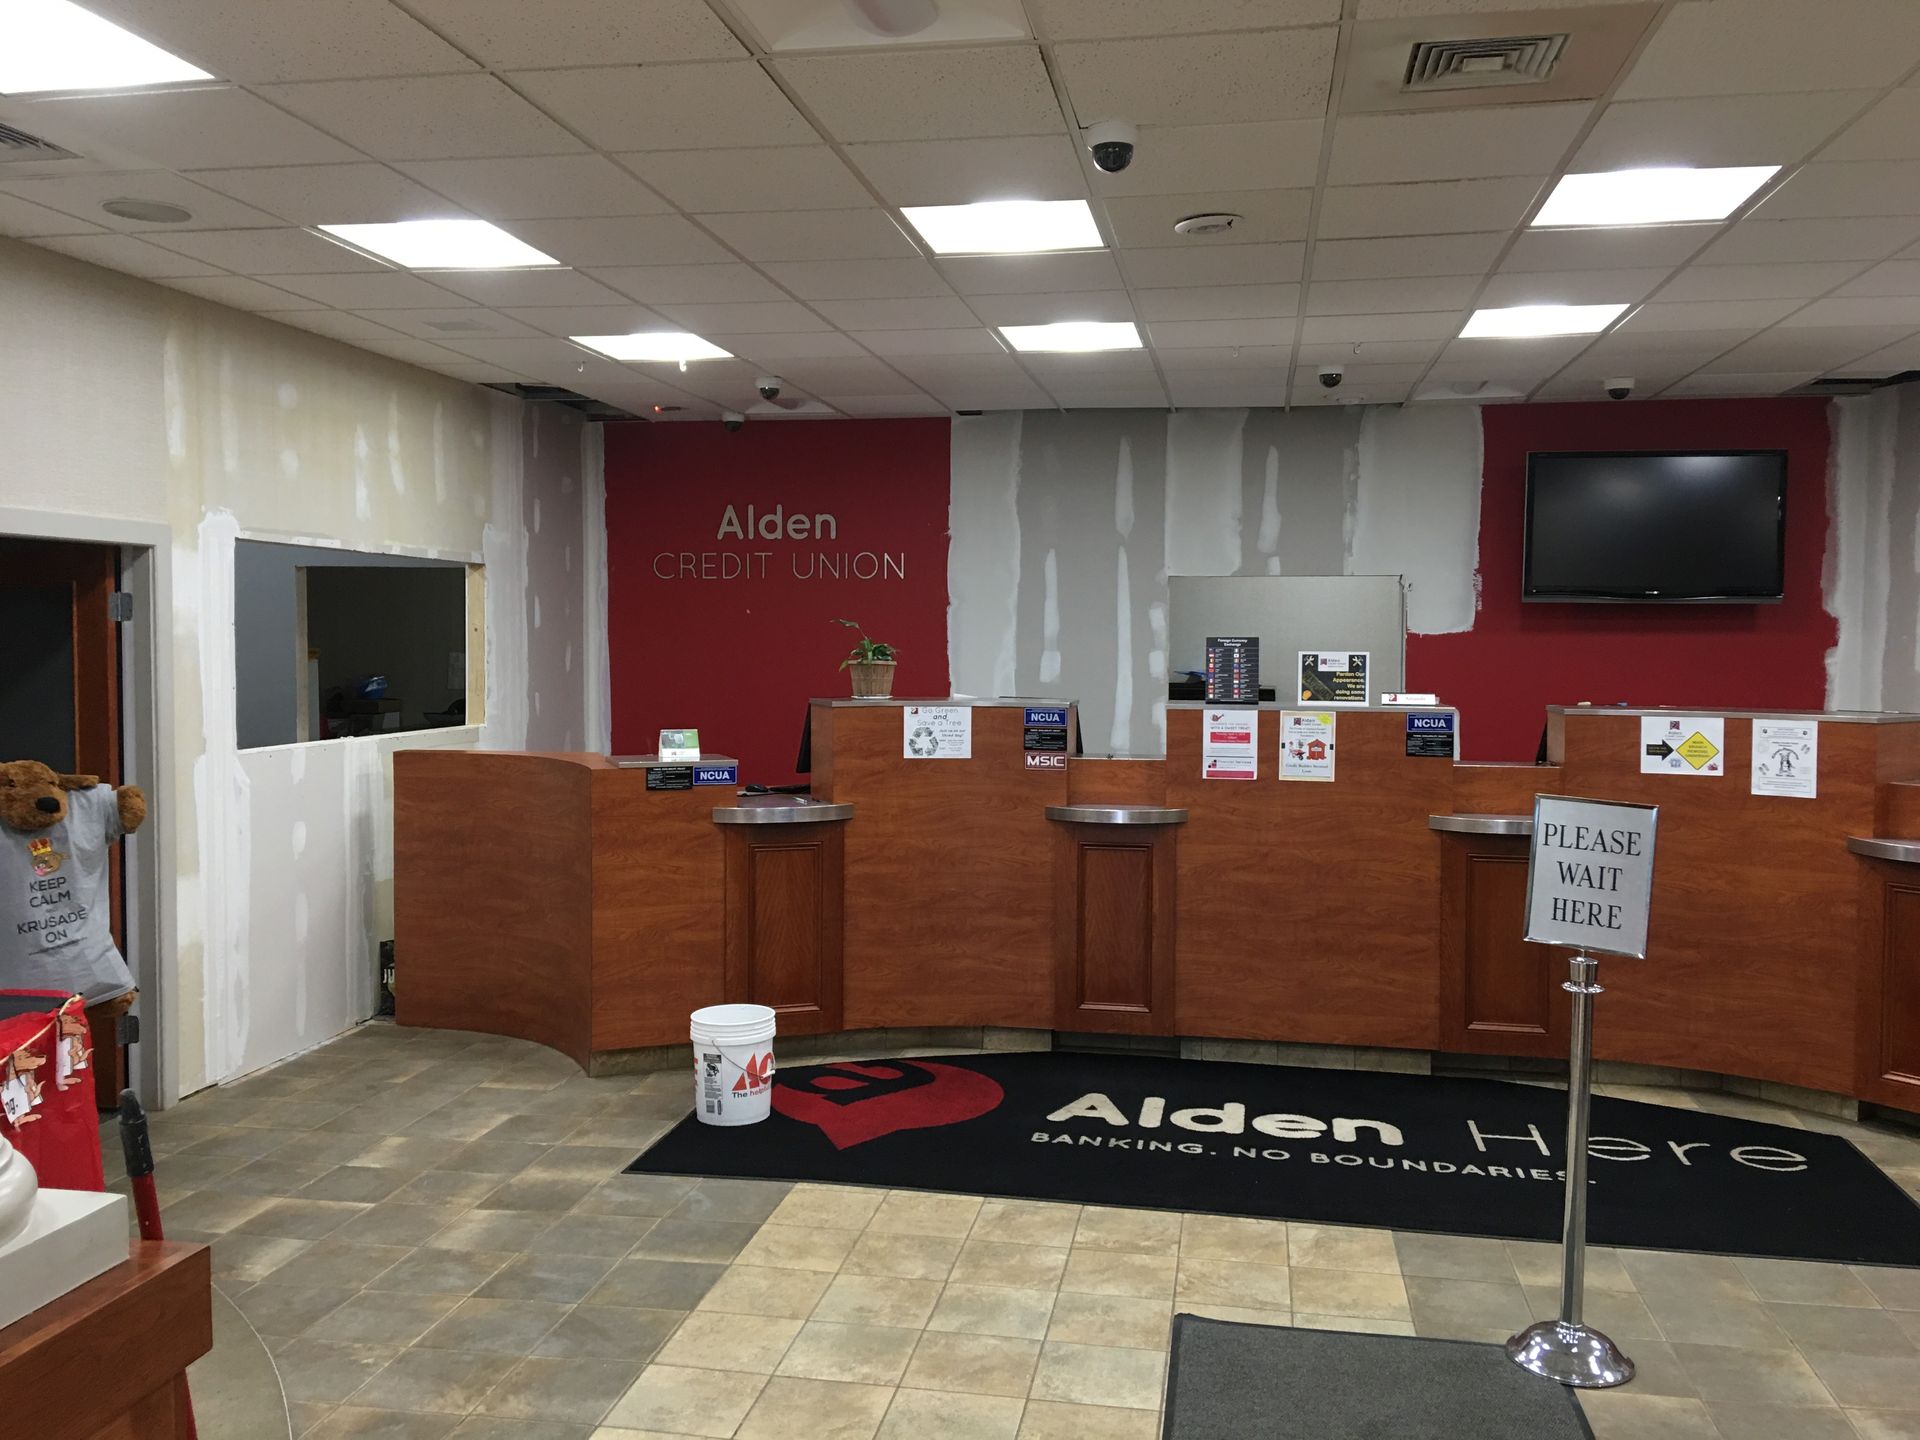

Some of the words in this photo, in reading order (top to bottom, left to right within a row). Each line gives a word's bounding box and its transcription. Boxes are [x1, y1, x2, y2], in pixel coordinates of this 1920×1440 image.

[717, 504, 837, 540] Alden
[653, 552, 773, 579] CREDIT
[792, 552, 905, 580] UNION
[1031, 713, 1060, 721] NCUA
[1414, 718, 1446, 728] NCUA
[1027, 755, 1065, 766] MSIC
[700, 771, 730, 780] NCUA
[1542, 823, 1641, 857] PLEASE
[29, 876, 67, 893] KEEP
[1557, 861, 1623, 891] WAIT
[29, 890, 71, 908] CALM
[16, 907, 88, 935] KRUSADE
[1551, 897, 1622, 930] HERE
[45, 929, 68, 943] ON
[1046, 1093, 1404, 1146] Alden
[1467, 1119, 1808, 1171] Here
[1031, 1132, 1217, 1155] BANKING.
[1233, 1147, 1291, 1161] NO
